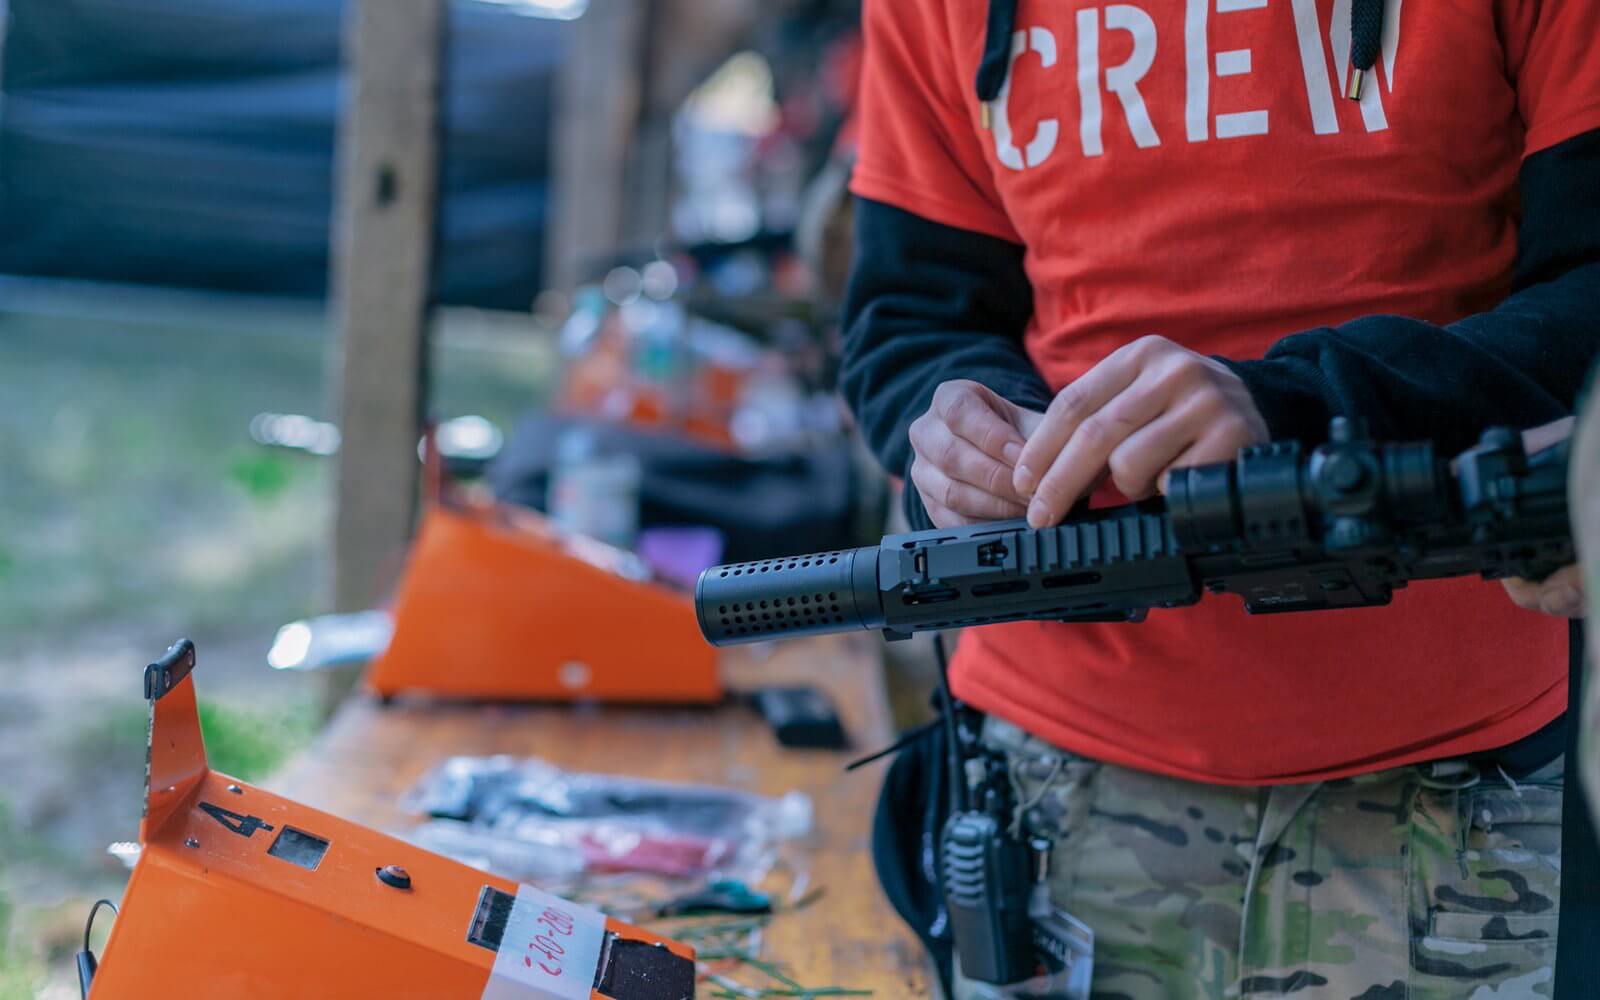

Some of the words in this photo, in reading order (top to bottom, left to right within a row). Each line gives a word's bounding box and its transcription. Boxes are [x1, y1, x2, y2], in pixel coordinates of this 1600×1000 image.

[992, 0, 1401, 170] CREW
[197, 801, 274, 838] 4
[523, 906, 575, 977] 270-280
